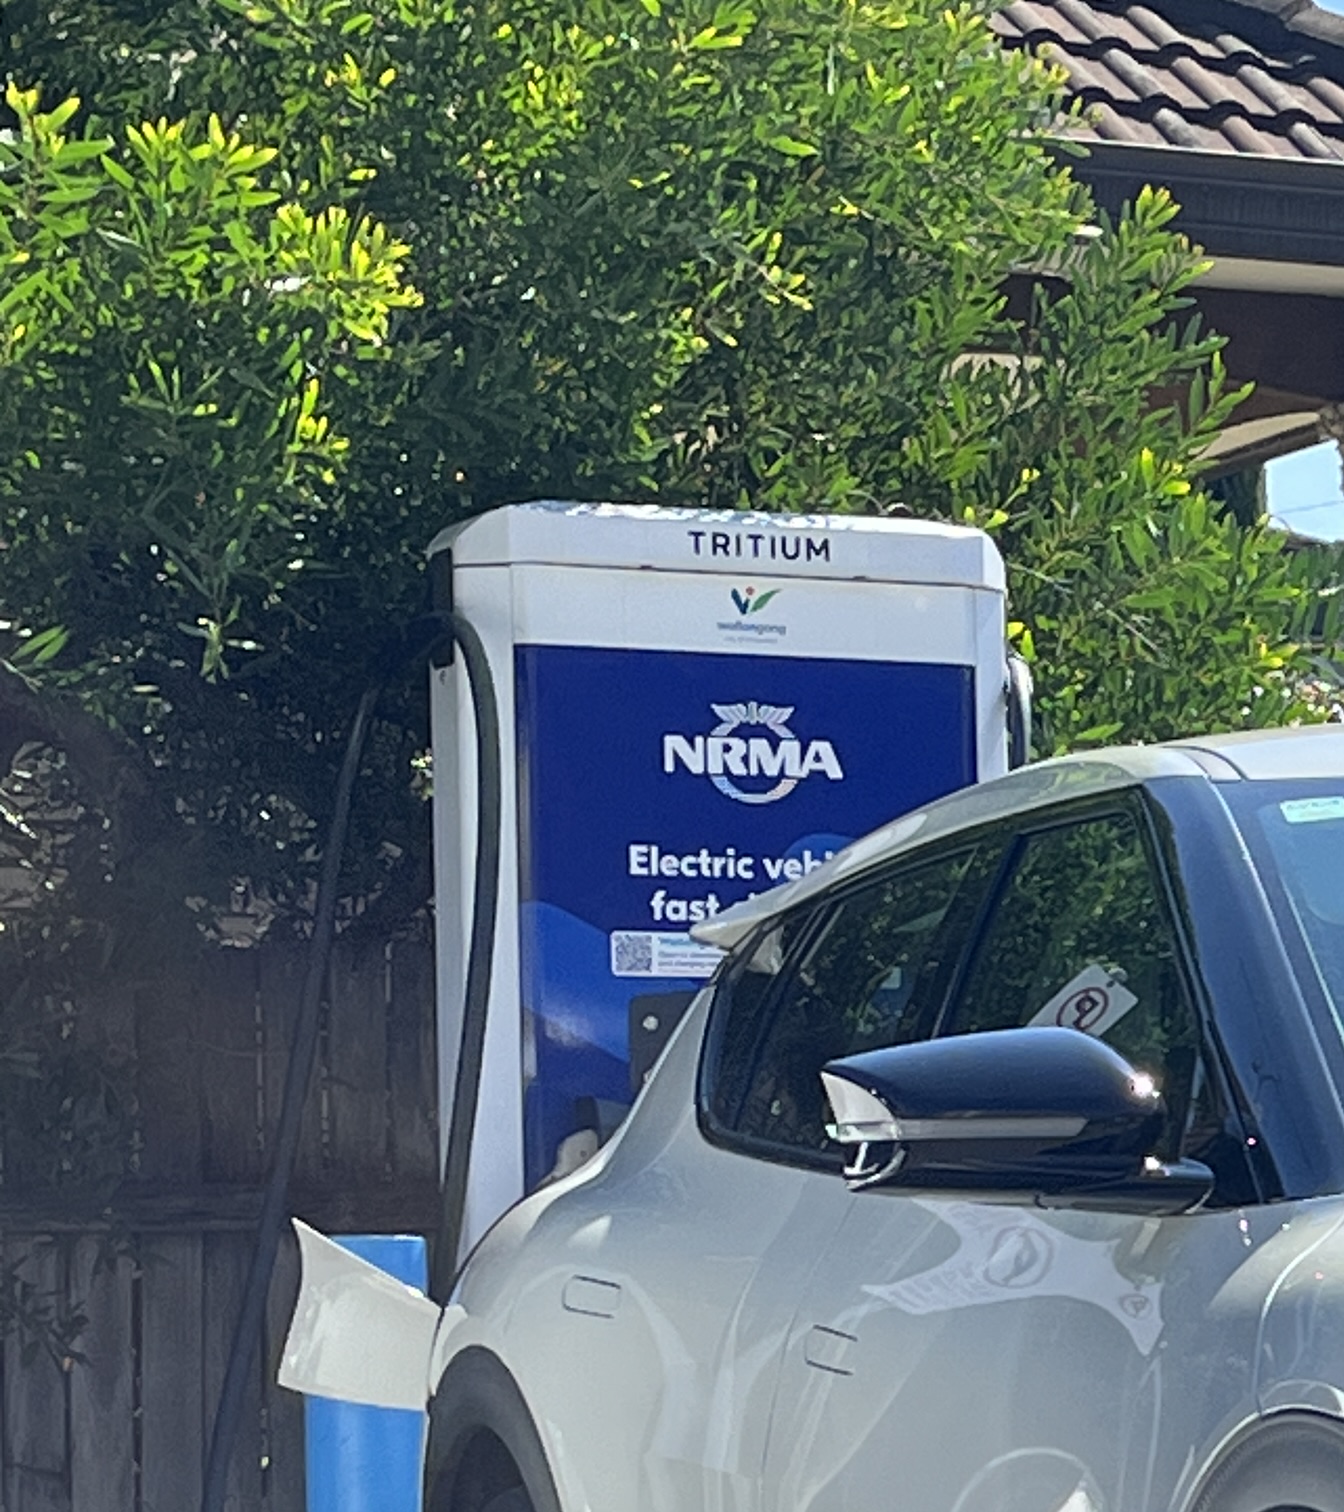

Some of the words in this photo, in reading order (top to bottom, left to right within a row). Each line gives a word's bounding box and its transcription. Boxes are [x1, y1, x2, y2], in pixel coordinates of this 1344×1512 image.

[687, 530, 831, 563] TRITIUM
[664, 734, 844, 780] NRMA
[628, 844, 755, 879] Electric
[762, 849, 834, 881] veh
[650, 889, 721, 922] fast
